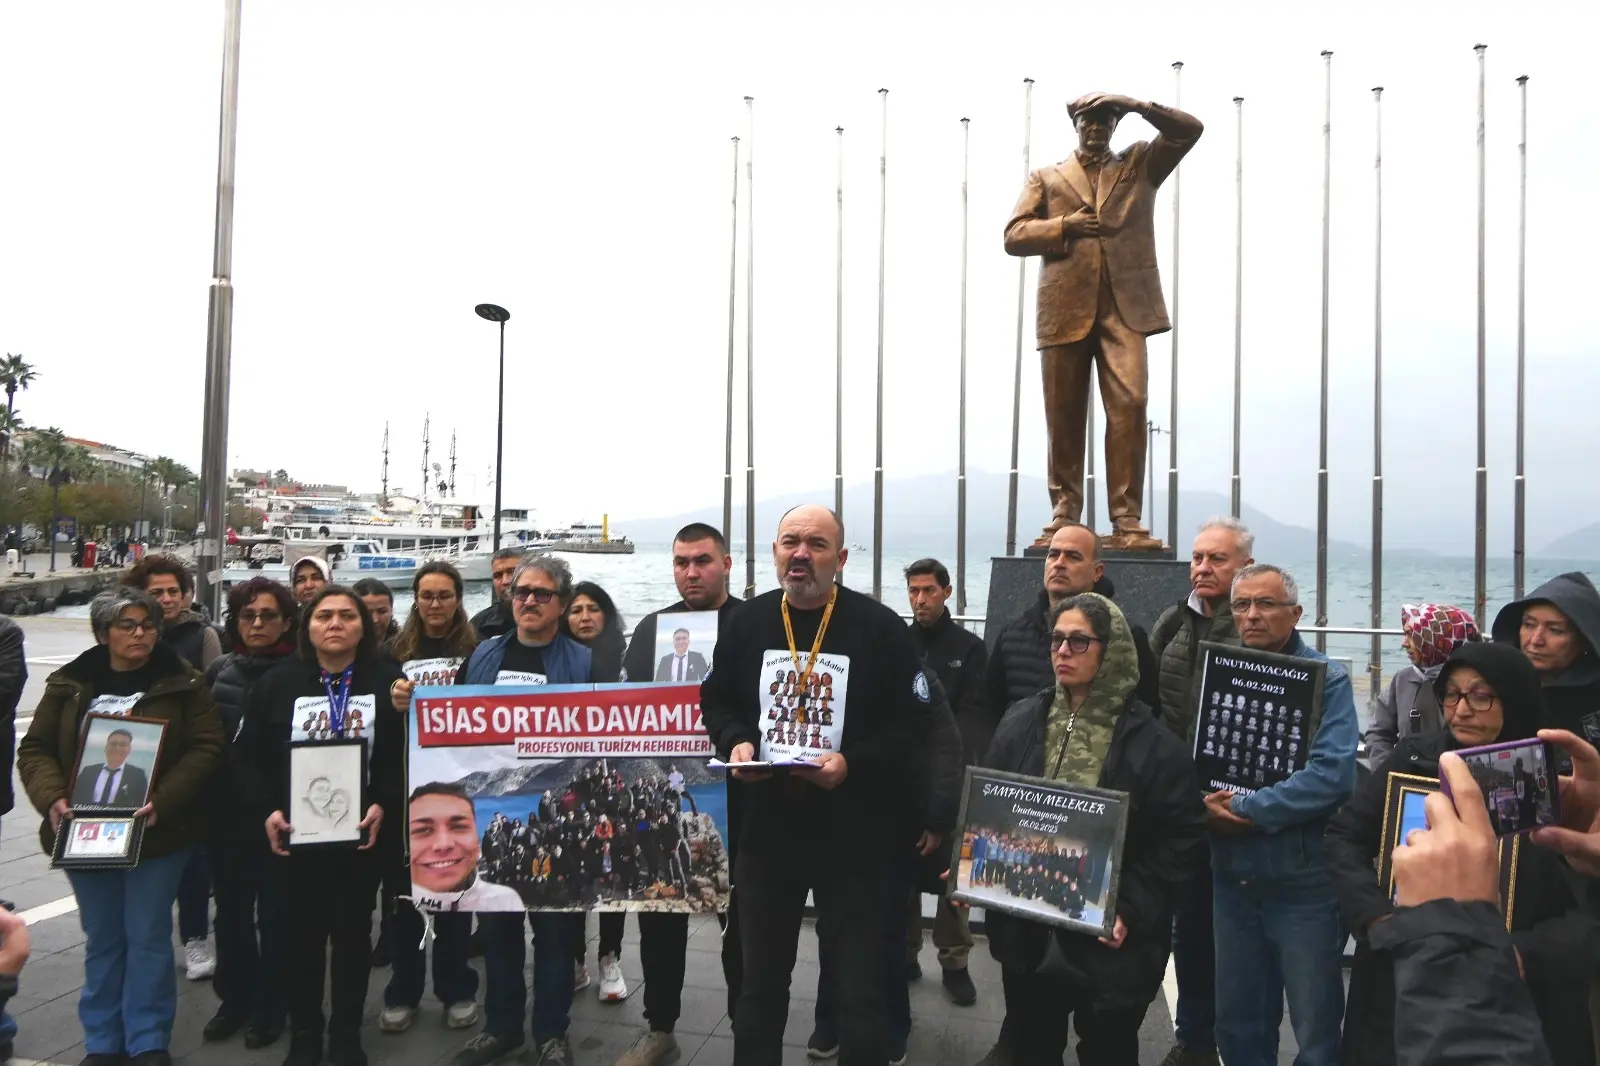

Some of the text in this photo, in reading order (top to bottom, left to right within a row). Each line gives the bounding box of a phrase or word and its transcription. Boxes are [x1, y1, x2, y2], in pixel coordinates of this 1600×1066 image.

[819, 658, 844, 674] Adalet
[1215, 656, 1309, 681] UNUTMAYACAĞIZ
[1232, 677, 1285, 695] 06.02.2023
[421, 701, 707, 734] İSİAS ORTAK DAVAMIZ
[518, 741, 596, 753] PROFESYONEL
[598, 738, 641, 752] TURİZM
[982, 783, 1106, 815] ŞAMPİYON MELEKLER
[1012, 804, 1068, 824] Unutmayacağız
[1018, 818, 1058, 834] 06.02.2023
